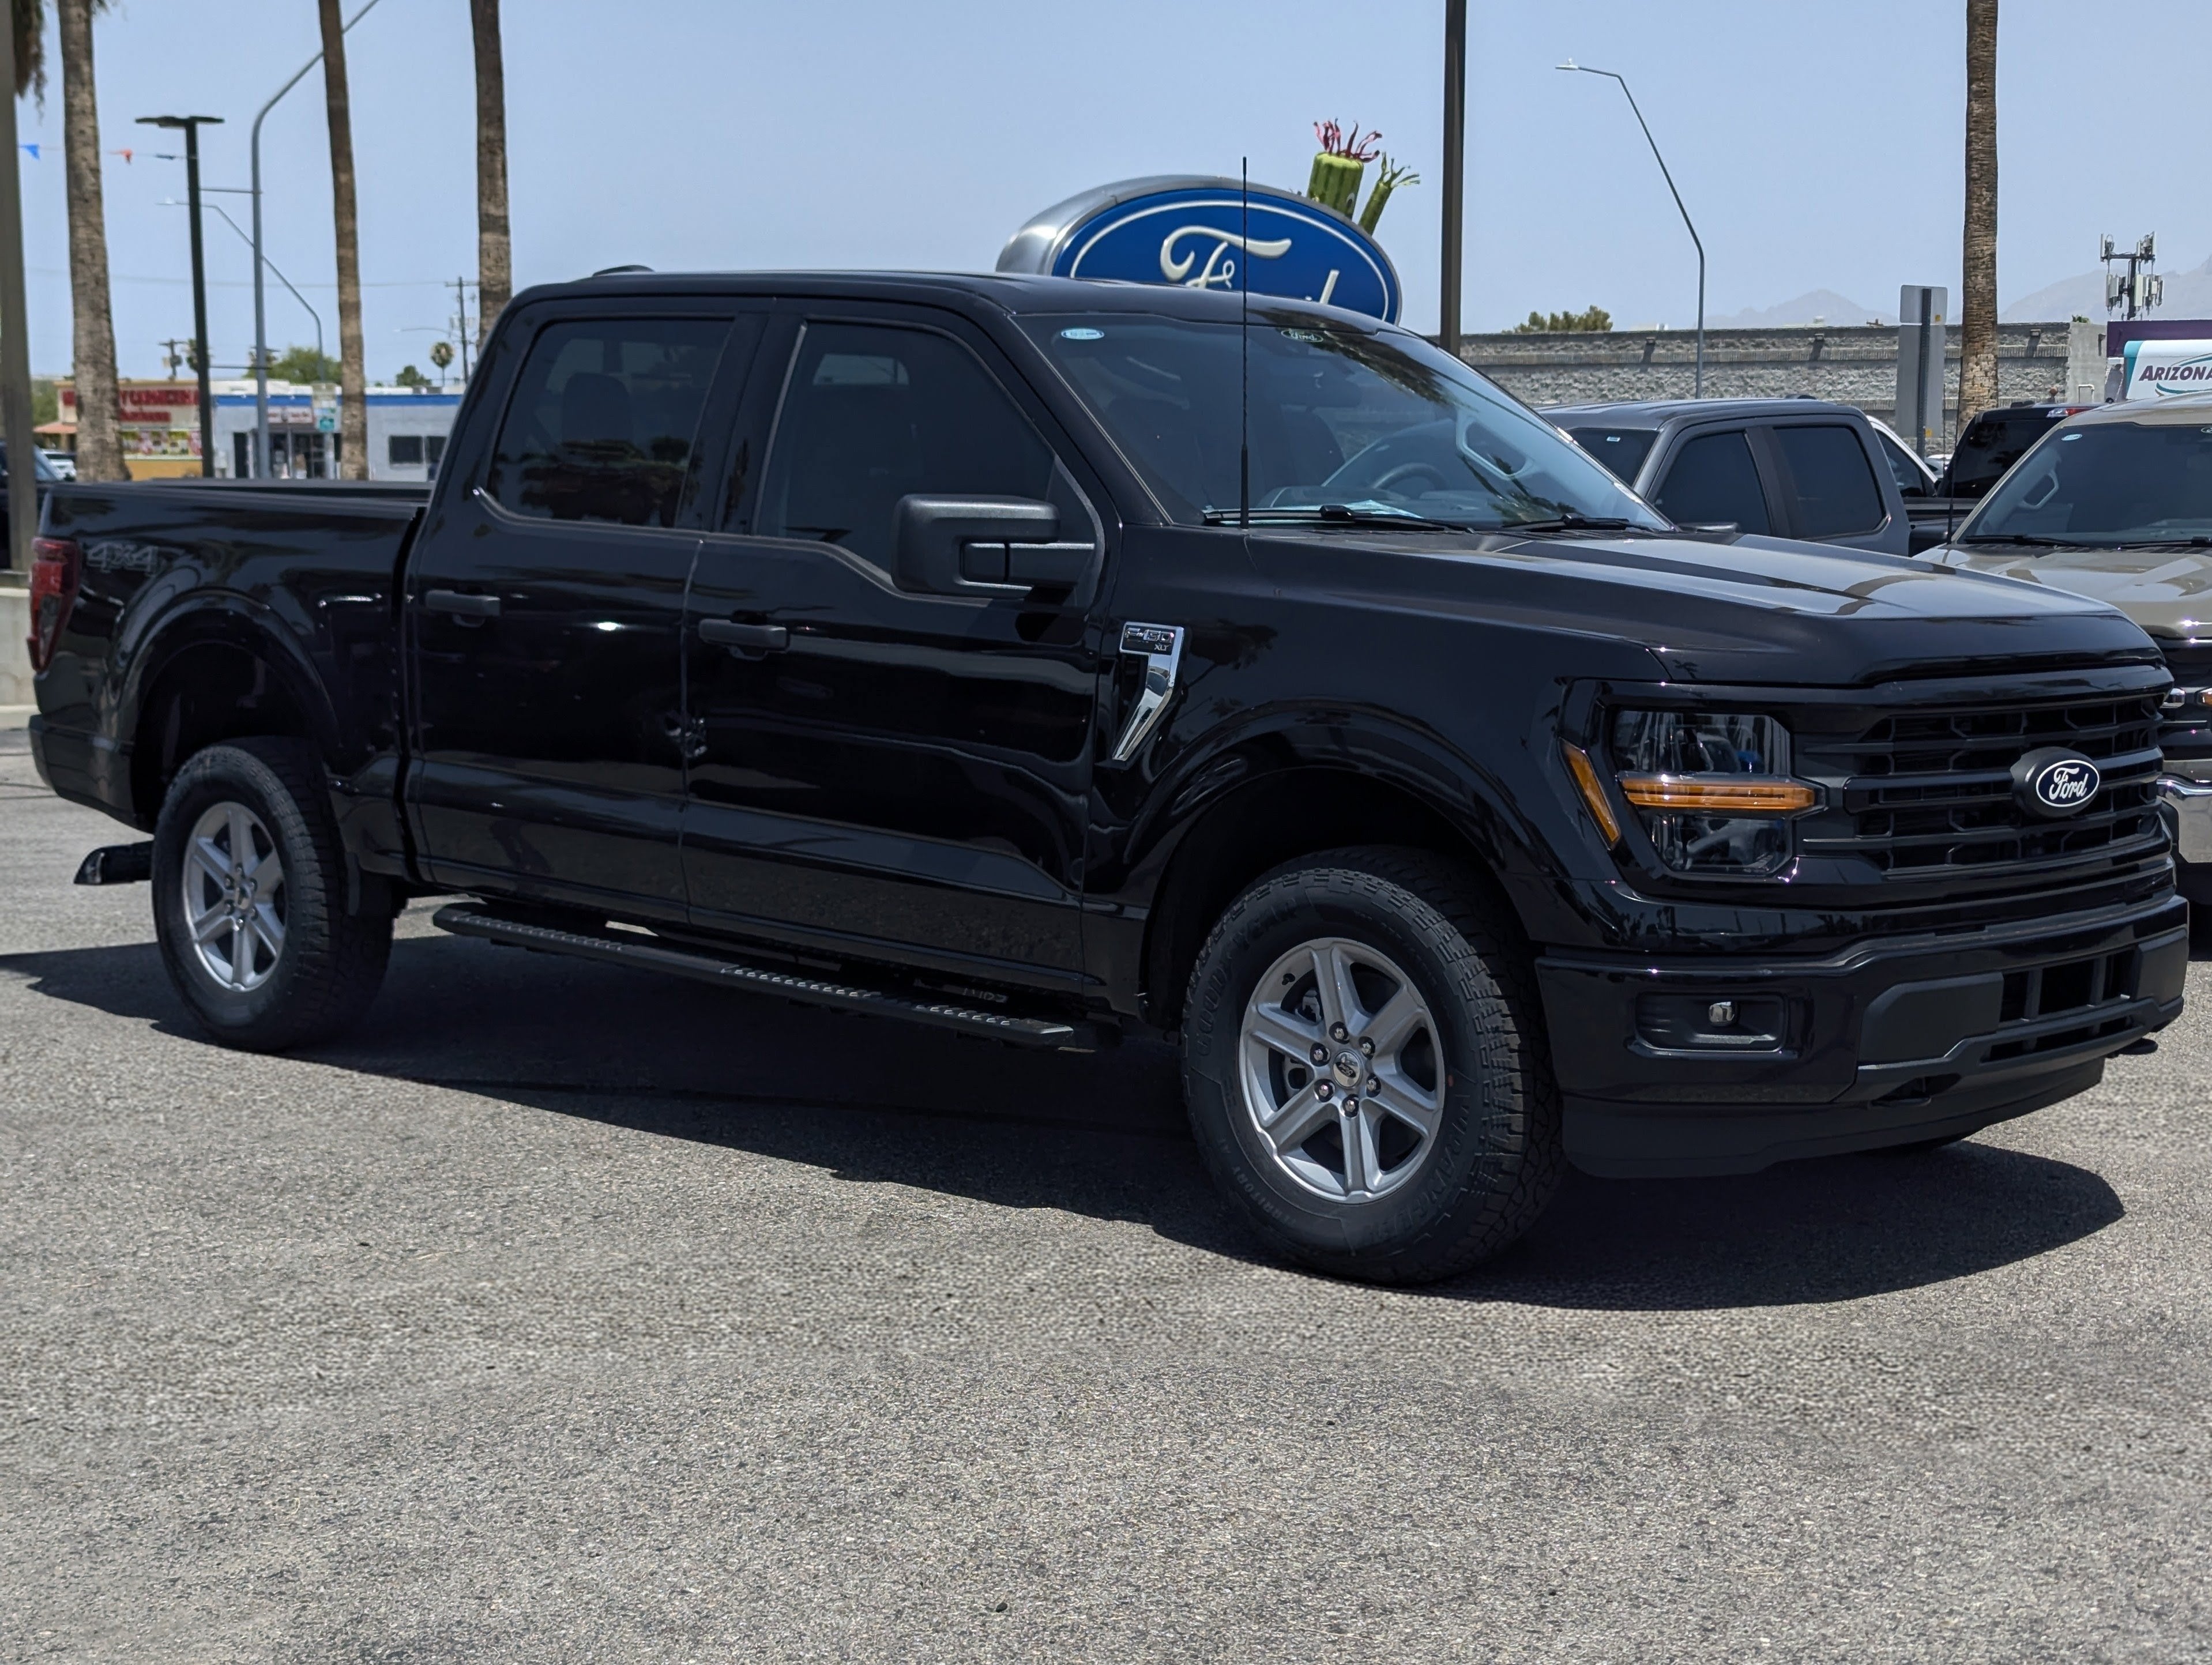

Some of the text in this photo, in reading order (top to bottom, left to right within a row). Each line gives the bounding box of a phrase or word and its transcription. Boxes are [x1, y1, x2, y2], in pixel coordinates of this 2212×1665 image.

[1124, 627, 1174, 643] F-150
[1154, 643, 1171, 651] XLT
[2049, 767, 2089, 800] Ford
